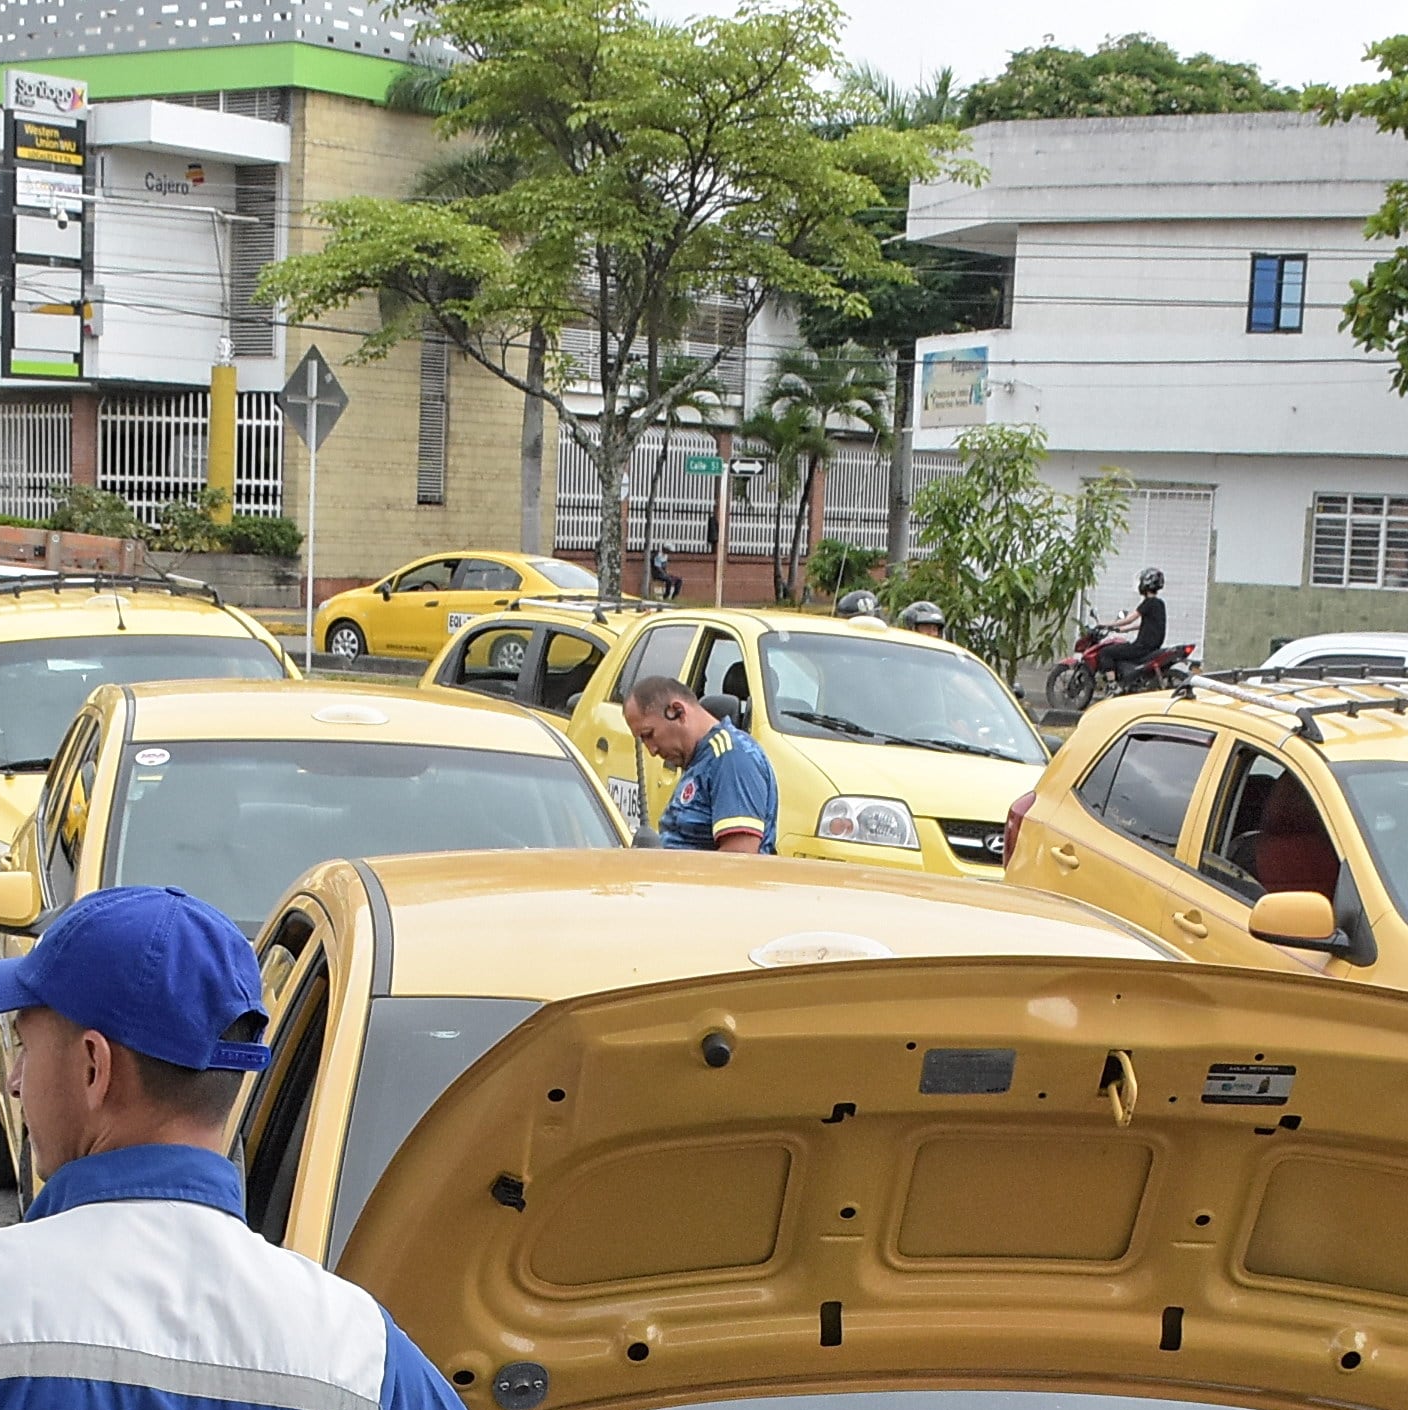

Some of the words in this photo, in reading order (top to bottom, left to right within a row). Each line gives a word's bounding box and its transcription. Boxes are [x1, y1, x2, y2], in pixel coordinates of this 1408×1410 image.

[16, 77, 74, 111] Santiago
[24, 123, 60, 139] Western
[35, 137, 59, 150] Union
[145, 172, 189, 196] Cajero
